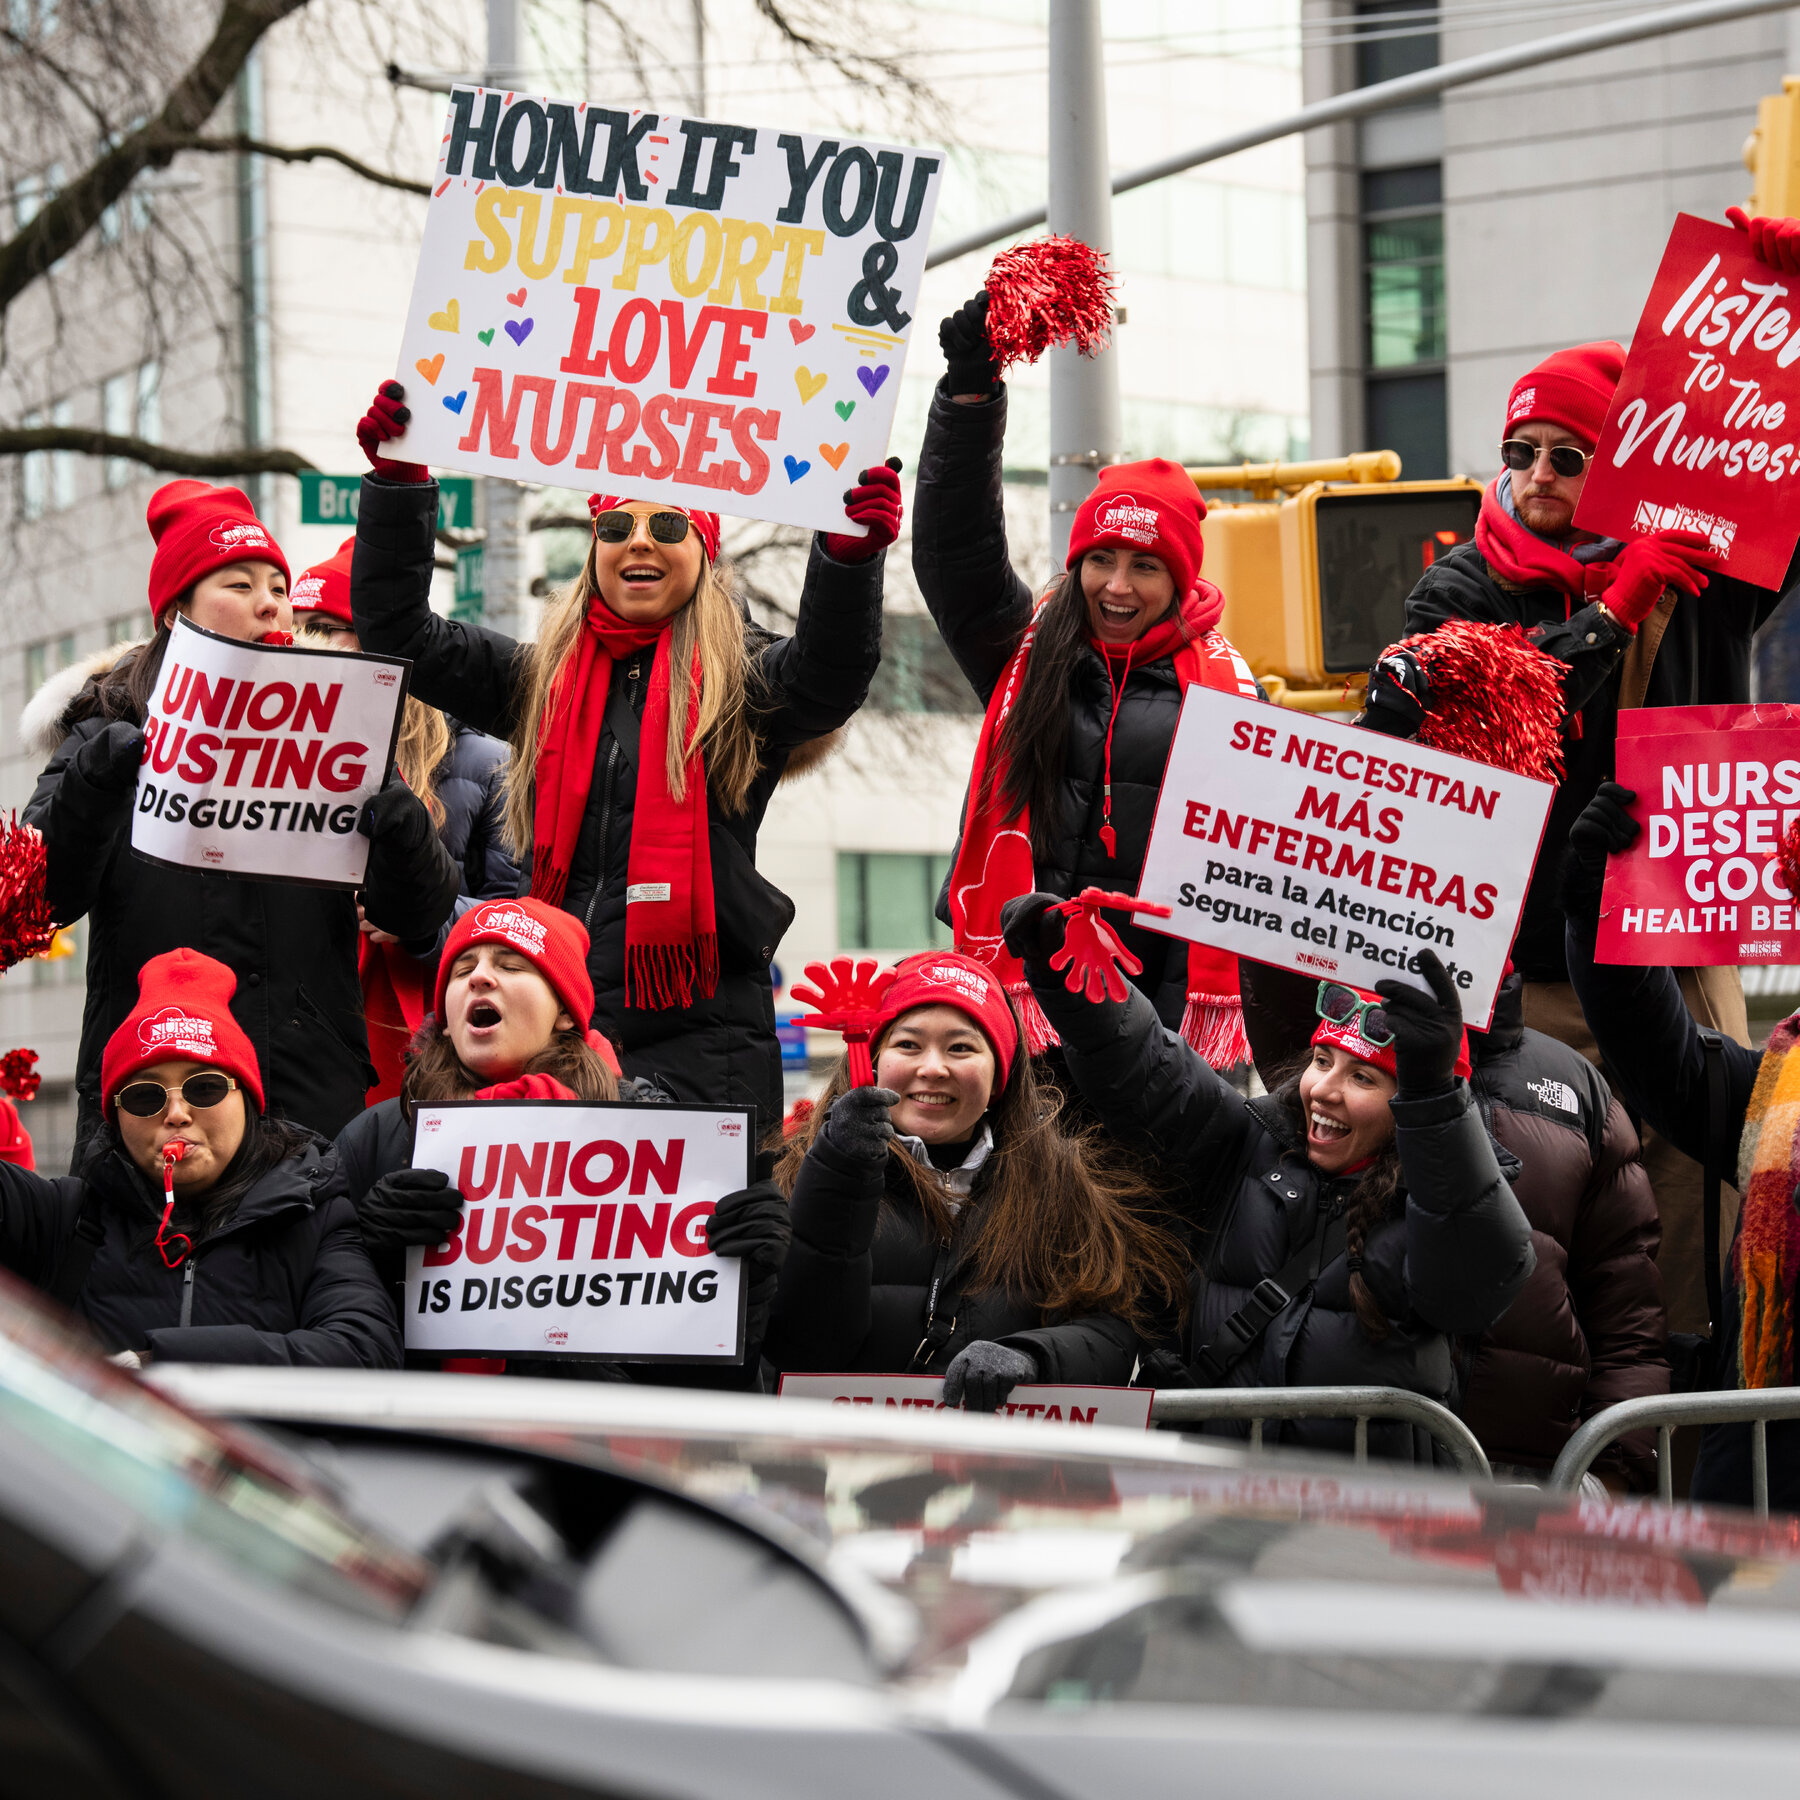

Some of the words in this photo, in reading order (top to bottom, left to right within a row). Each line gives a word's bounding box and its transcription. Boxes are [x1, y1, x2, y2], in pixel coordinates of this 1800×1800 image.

[445, 90, 659, 201] HONK
[666, 118, 757, 211] IF
[776, 133, 940, 242] YOU
[464, 186, 826, 315] SUPPORT
[846, 241, 913, 333] &
[560, 287, 768, 398] LOVE
[458, 367, 781, 496] NURSES
[1104, 508, 1158, 526] NURSES
[1633, 499, 1736, 549] NURSES
[1675, 502, 1696, 517] New
[1696, 508, 1715, 524] York
[1716, 516, 1738, 531] State
[162, 662, 344, 733] UNION
[1230, 720, 1278, 758] SE
[1281, 734, 1502, 820] NECESITAN
[139, 782, 358, 835] DISGUSTING
[1295, 785, 1404, 845] MÁS
[1182, 800, 1499, 920] ENFERMERAS
[487, 912, 546, 939] NURSES
[1205, 859, 1274, 896] para
[1282, 875, 1308, 906] la
[1314, 887, 1455, 948] Atención
[1621, 906, 1738, 933] HEALTH
[1177, 883, 1283, 934] Segura
[1291, 916, 1336, 950] del
[1345, 929, 1474, 990] Paciete
[1739, 943, 1782, 953] NURSES
[932, 966, 989, 993] NURSES
[150, 1021, 213, 1036] NURSES
[1526, 1081, 1562, 1100] NORTH
[1538, 1091, 1562, 1109] FACE
[1541, 1077, 1562, 1091] THE
[458, 1138, 686, 1202] UNION
[418, 1279, 452, 1314] IS
[460, 1269, 719, 1312] DISGUSTING
